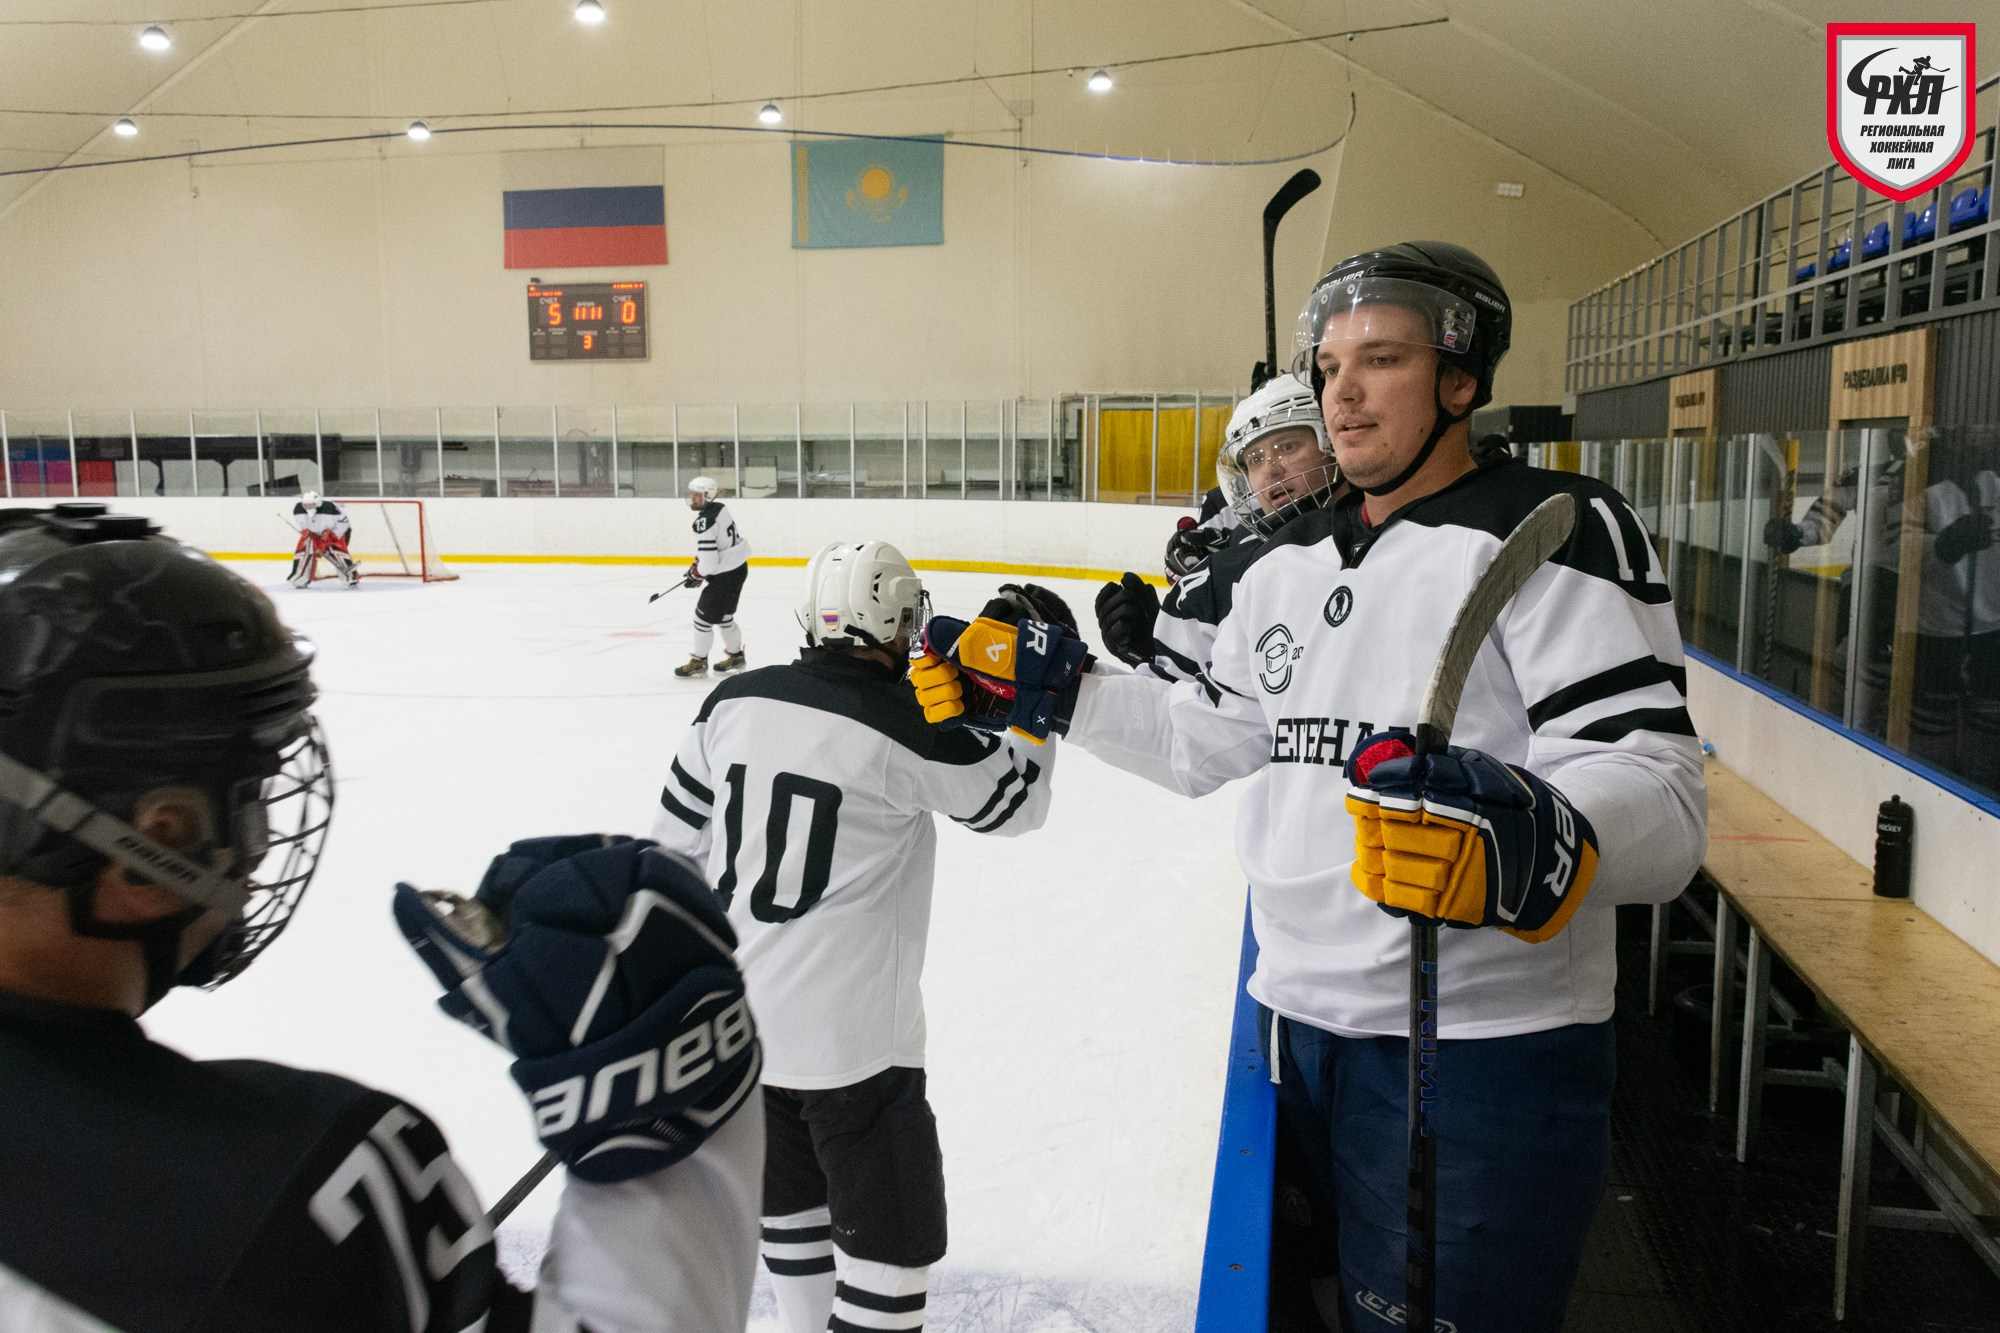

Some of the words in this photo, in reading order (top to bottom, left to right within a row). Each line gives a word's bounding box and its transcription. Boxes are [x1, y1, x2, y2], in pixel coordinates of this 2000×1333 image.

[548, 302, 562, 325] 5
[583, 333, 593, 350] 3
[622, 300, 636, 325] 0
[1589, 497, 1668, 585] 11
[714, 763, 842, 923] 10
[530, 995, 758, 1139] BAUE
[308, 1103, 496, 1333] 75
